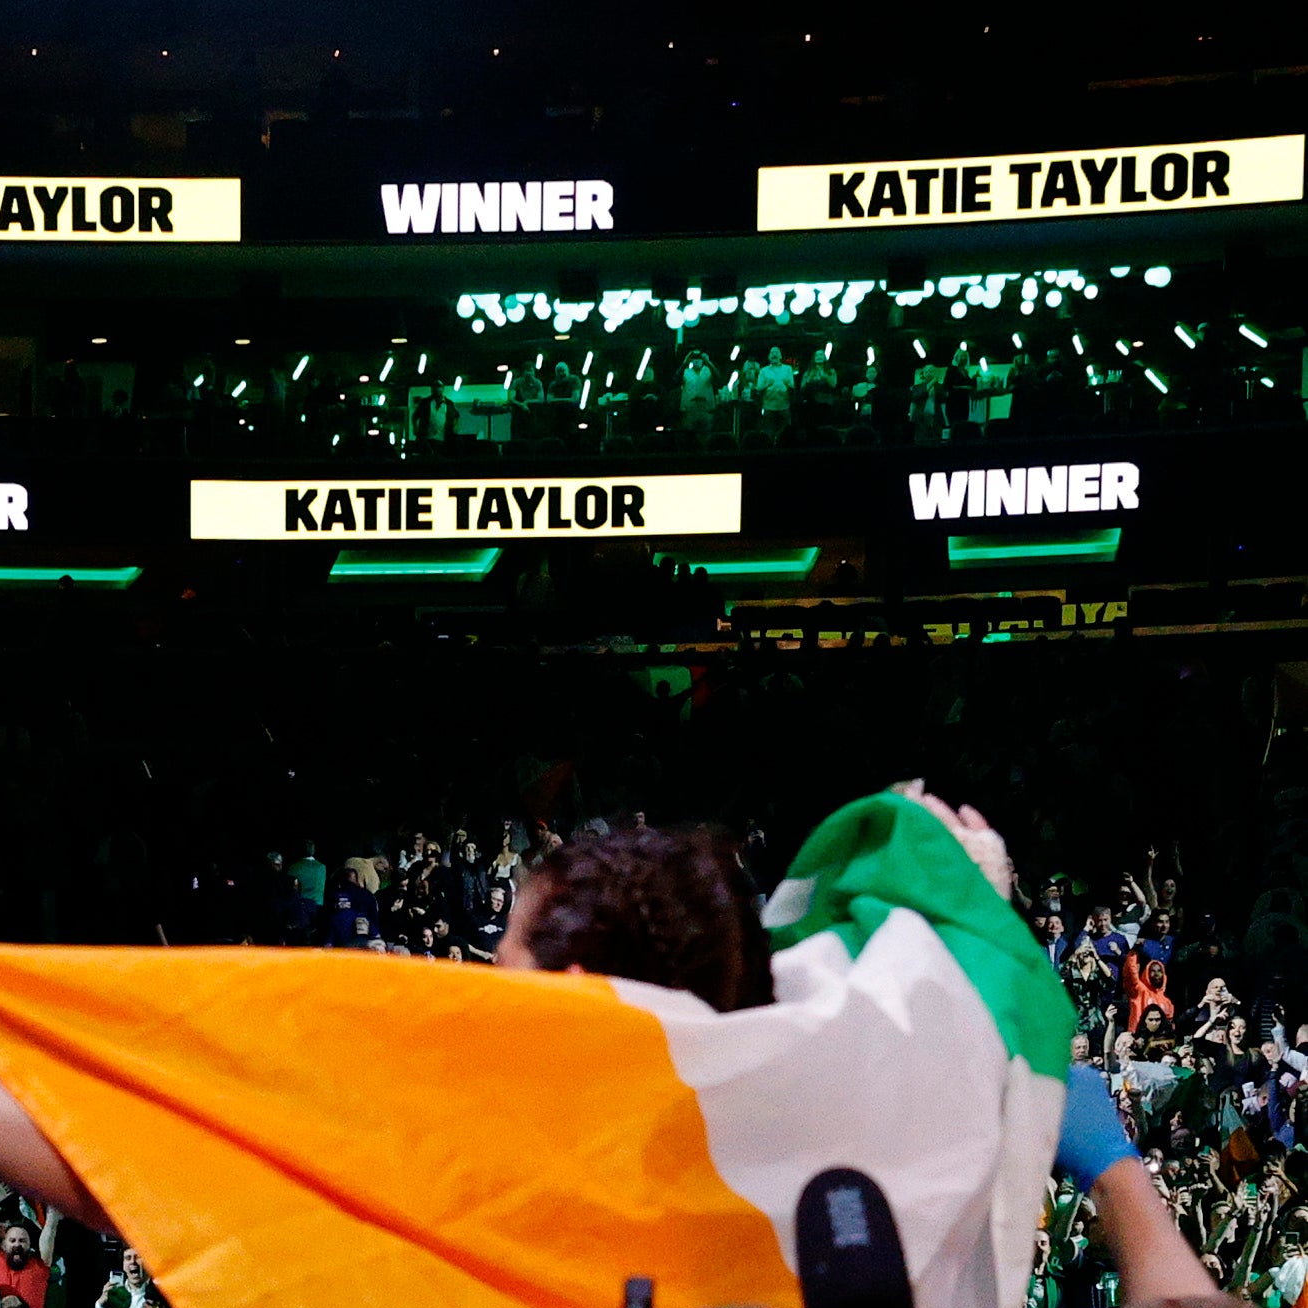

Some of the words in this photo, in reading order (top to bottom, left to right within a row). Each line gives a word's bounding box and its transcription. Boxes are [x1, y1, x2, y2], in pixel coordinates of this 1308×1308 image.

[379, 178, 615, 235] WINNER
[827, 163, 993, 220] KATIE
[1008, 149, 1231, 208] TAYLOR
[284, 483, 434, 533] KATIE
[447, 483, 646, 533] TAYLOR
[907, 460, 1141, 522] WINNER
